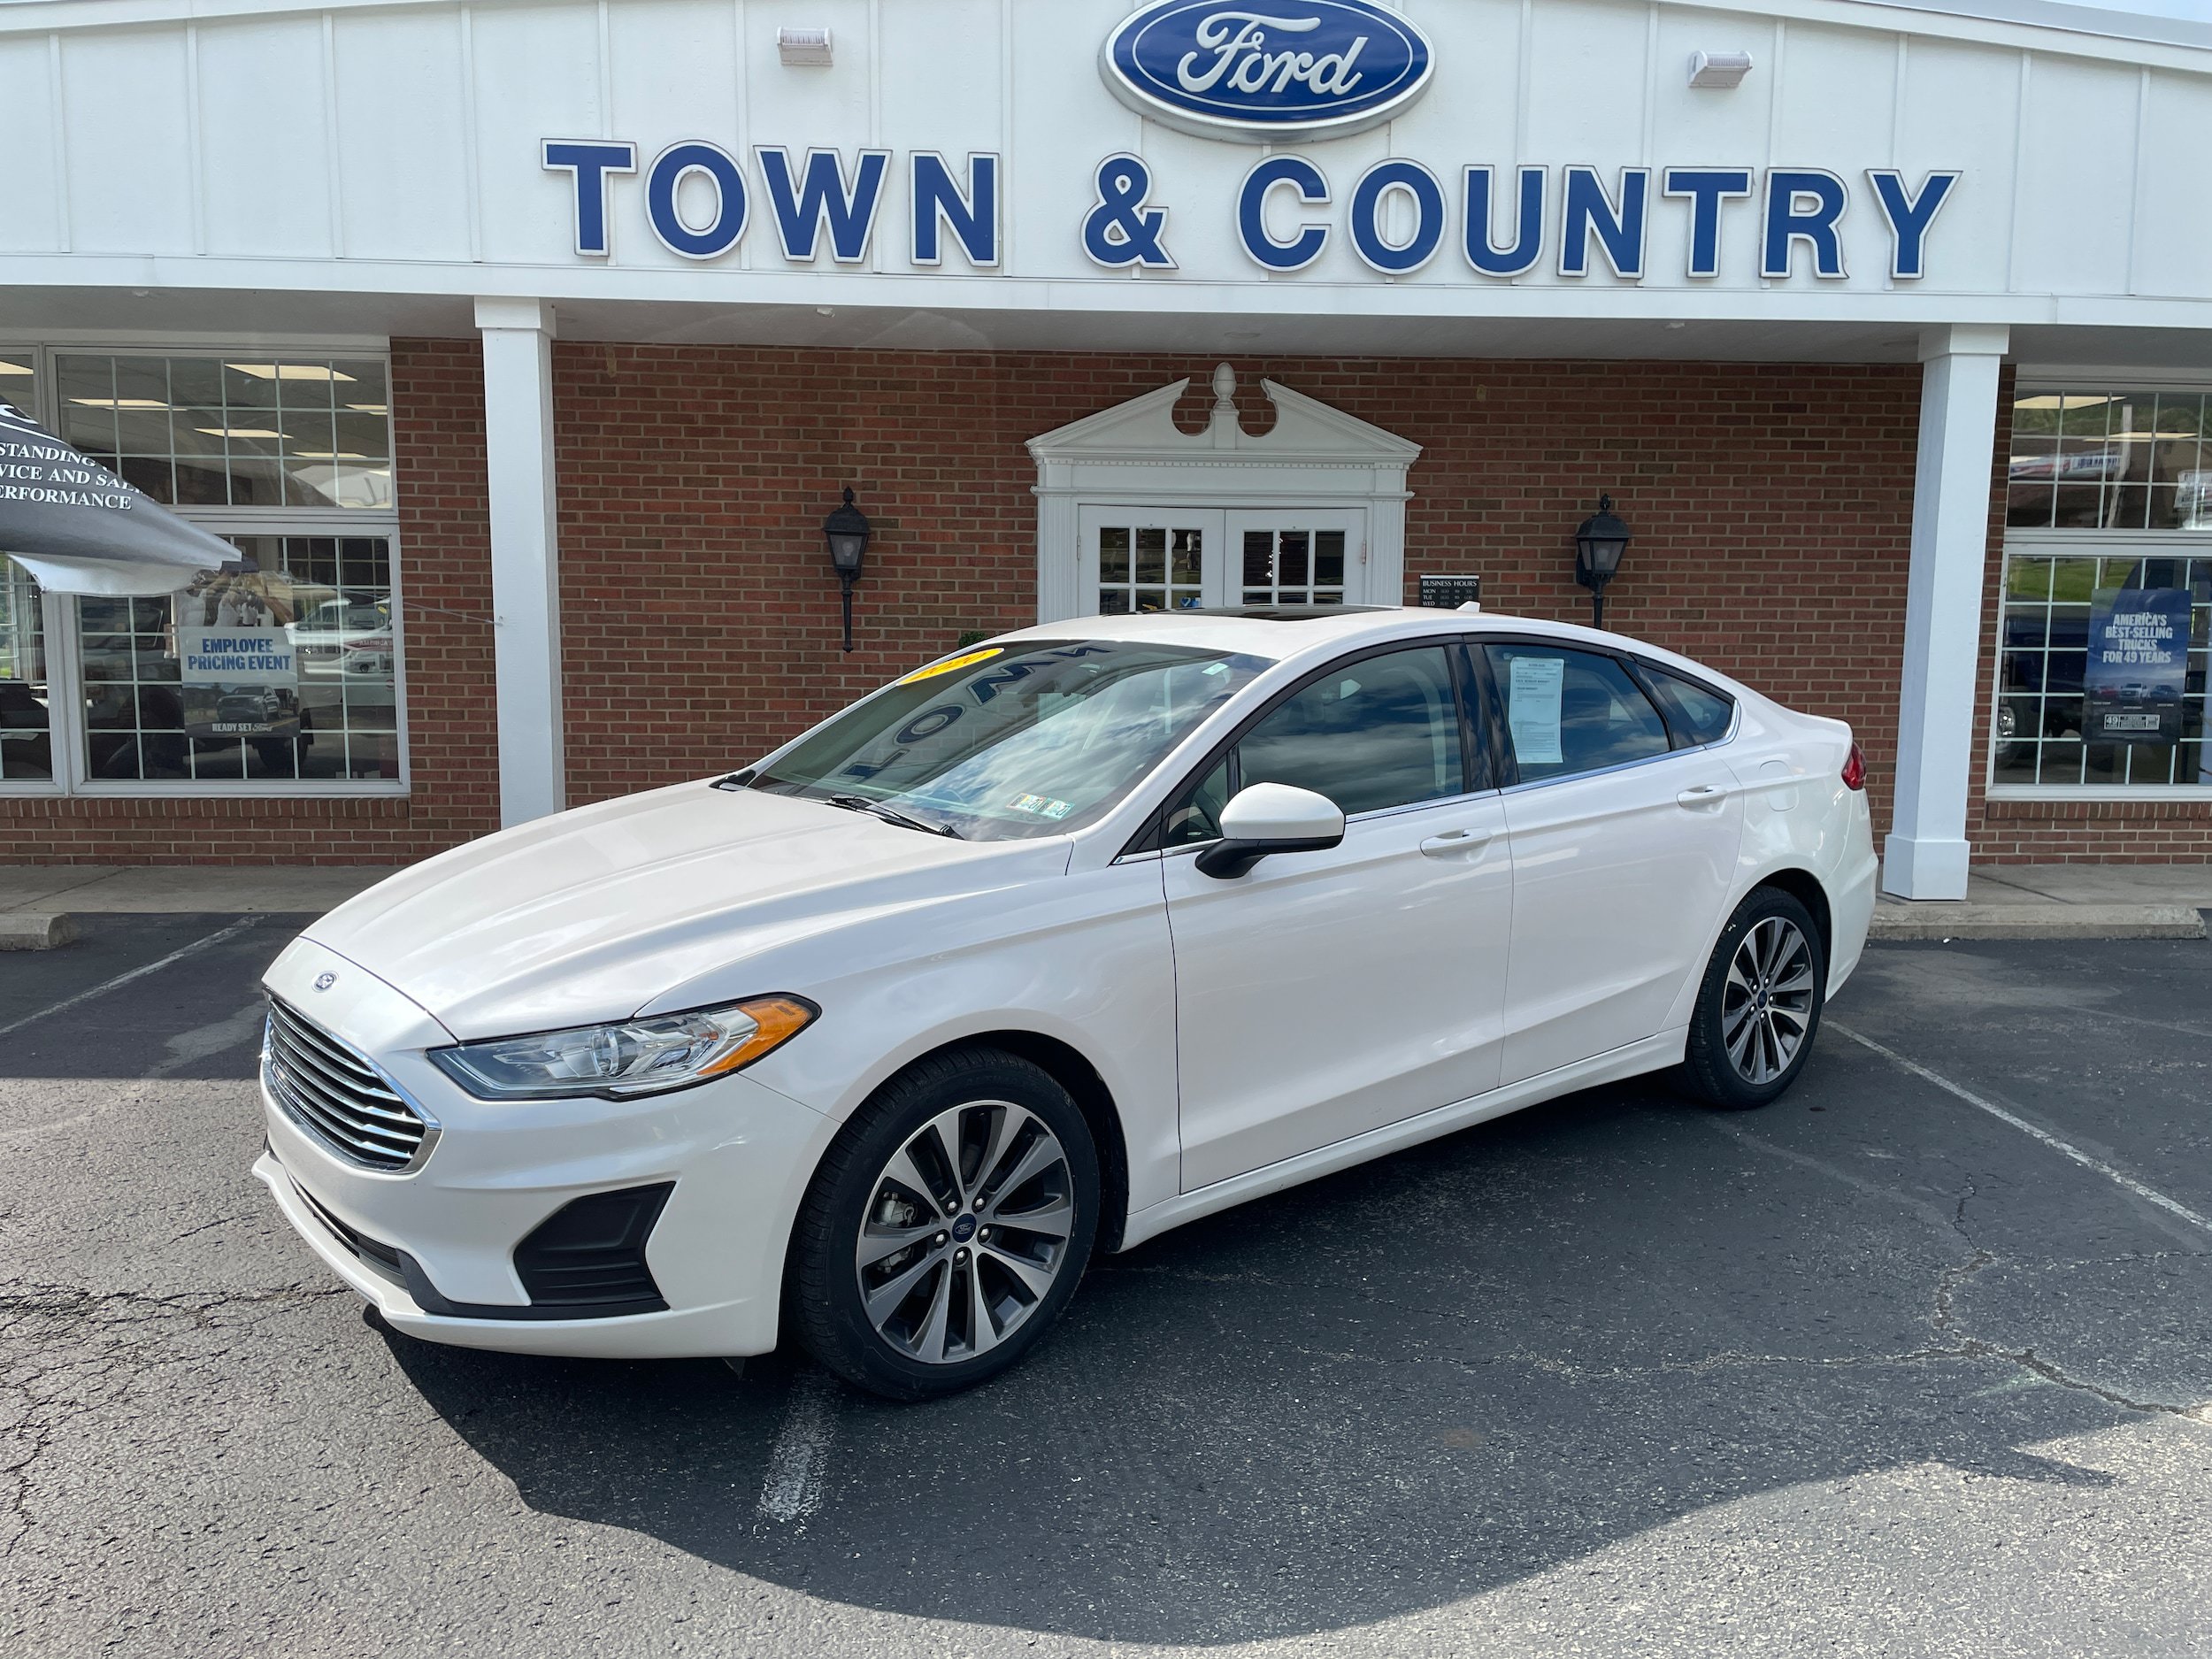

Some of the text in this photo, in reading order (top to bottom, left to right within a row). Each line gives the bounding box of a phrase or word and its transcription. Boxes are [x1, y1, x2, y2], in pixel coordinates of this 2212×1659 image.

[1177, 11, 1369, 95] Ford
[541, 138, 1963, 280] TOWN & COUNTRY
[48, 468, 90, 484] AND
[2113, 614, 2167, 626] AMERICA'S
[2106, 626, 2173, 639] BEST-SELLING
[203, 639, 273, 653] EMPLOYEE
[2118, 639, 2157, 650] TRUCKS
[188, 656, 290, 670] PRICING EVENT
[2103, 650, 2171, 663] FOR 49 YEARS
[212, 723, 237, 732] READY
[238, 723, 251, 732] SET
